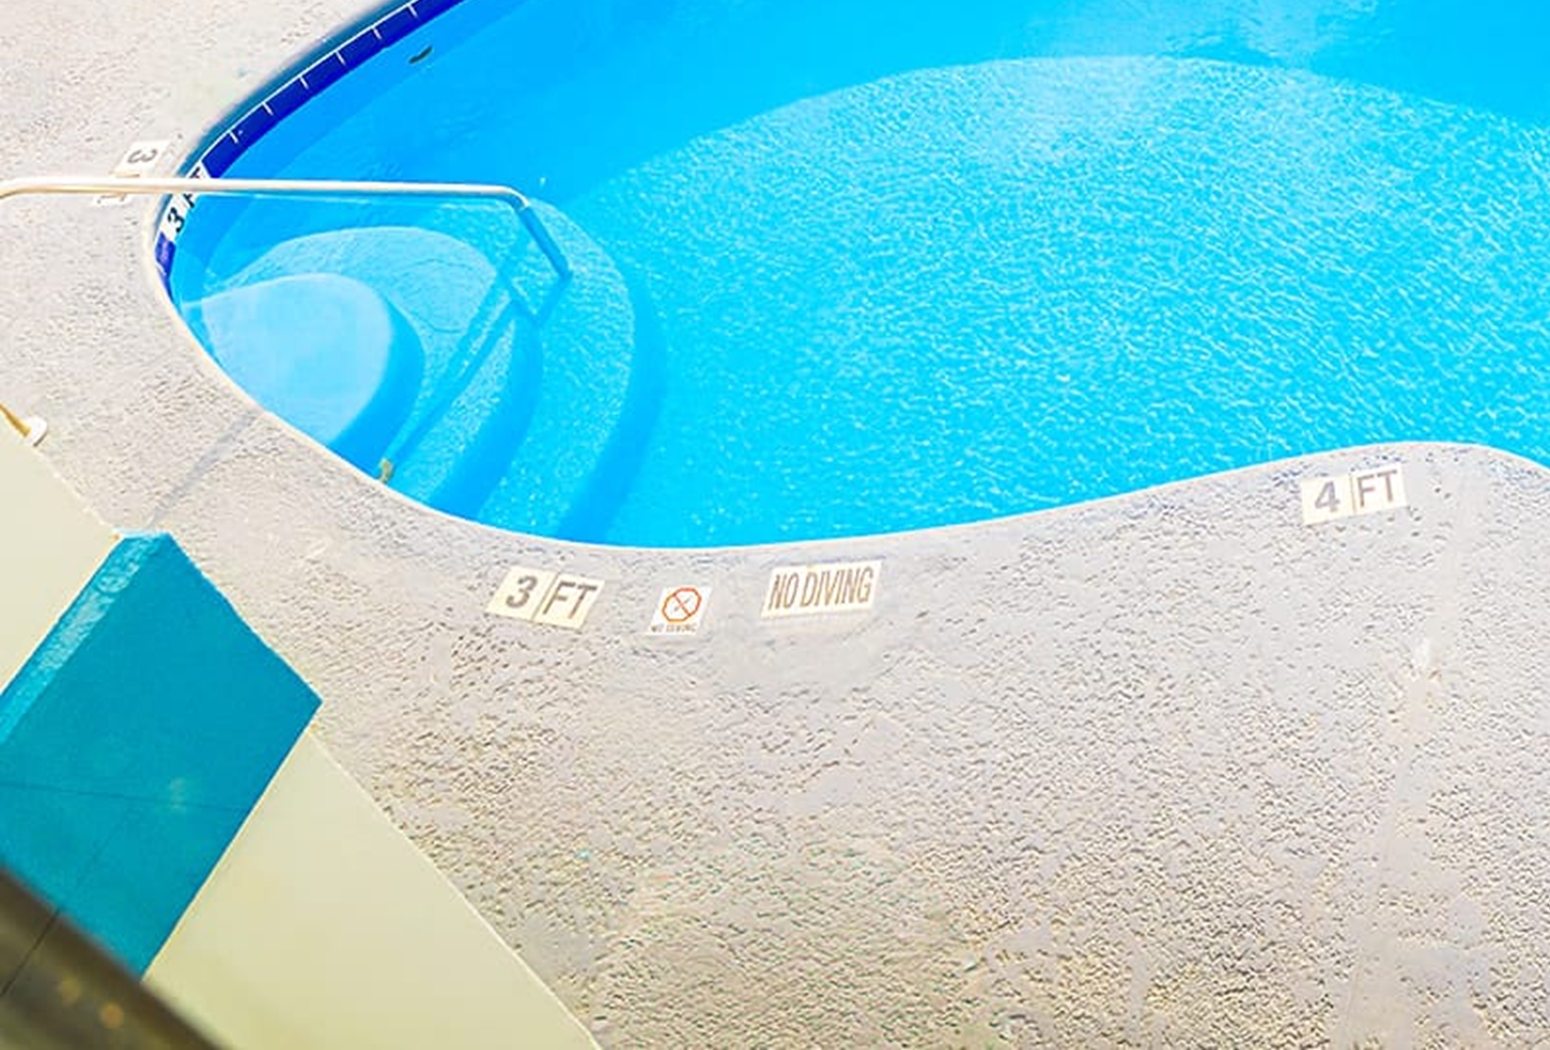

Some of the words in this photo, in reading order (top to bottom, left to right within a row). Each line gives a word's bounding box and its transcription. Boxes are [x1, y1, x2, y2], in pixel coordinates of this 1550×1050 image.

[127, 149, 157, 164] 3
[167, 206, 186, 234] 3
[1314, 480, 1340, 513] 4
[1357, 469, 1398, 508] FT
[506, 575, 538, 609] 3
[542, 580, 598, 620] FT
[768, 572, 799, 611] NO
[800, 566, 874, 607] DIVING
